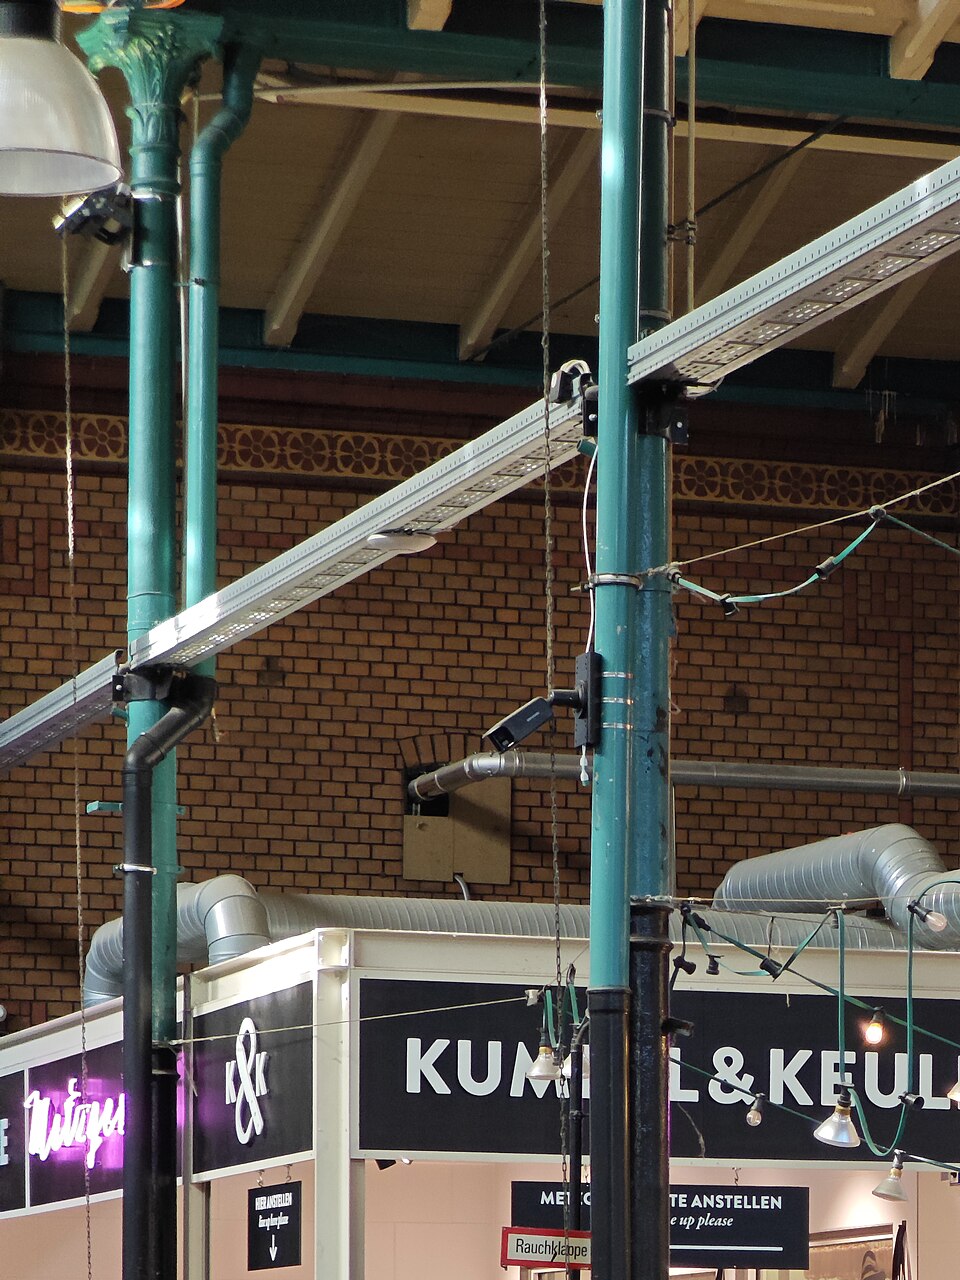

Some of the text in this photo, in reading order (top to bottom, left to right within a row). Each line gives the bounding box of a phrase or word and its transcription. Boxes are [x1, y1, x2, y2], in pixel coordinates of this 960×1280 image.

[691, 1193, 782, 1210] ANSTELLEN
[679, 1215, 695, 1229] up
[696, 1213, 734, 1229] please
[515, 1239, 588, 1258] Rauchklappe
